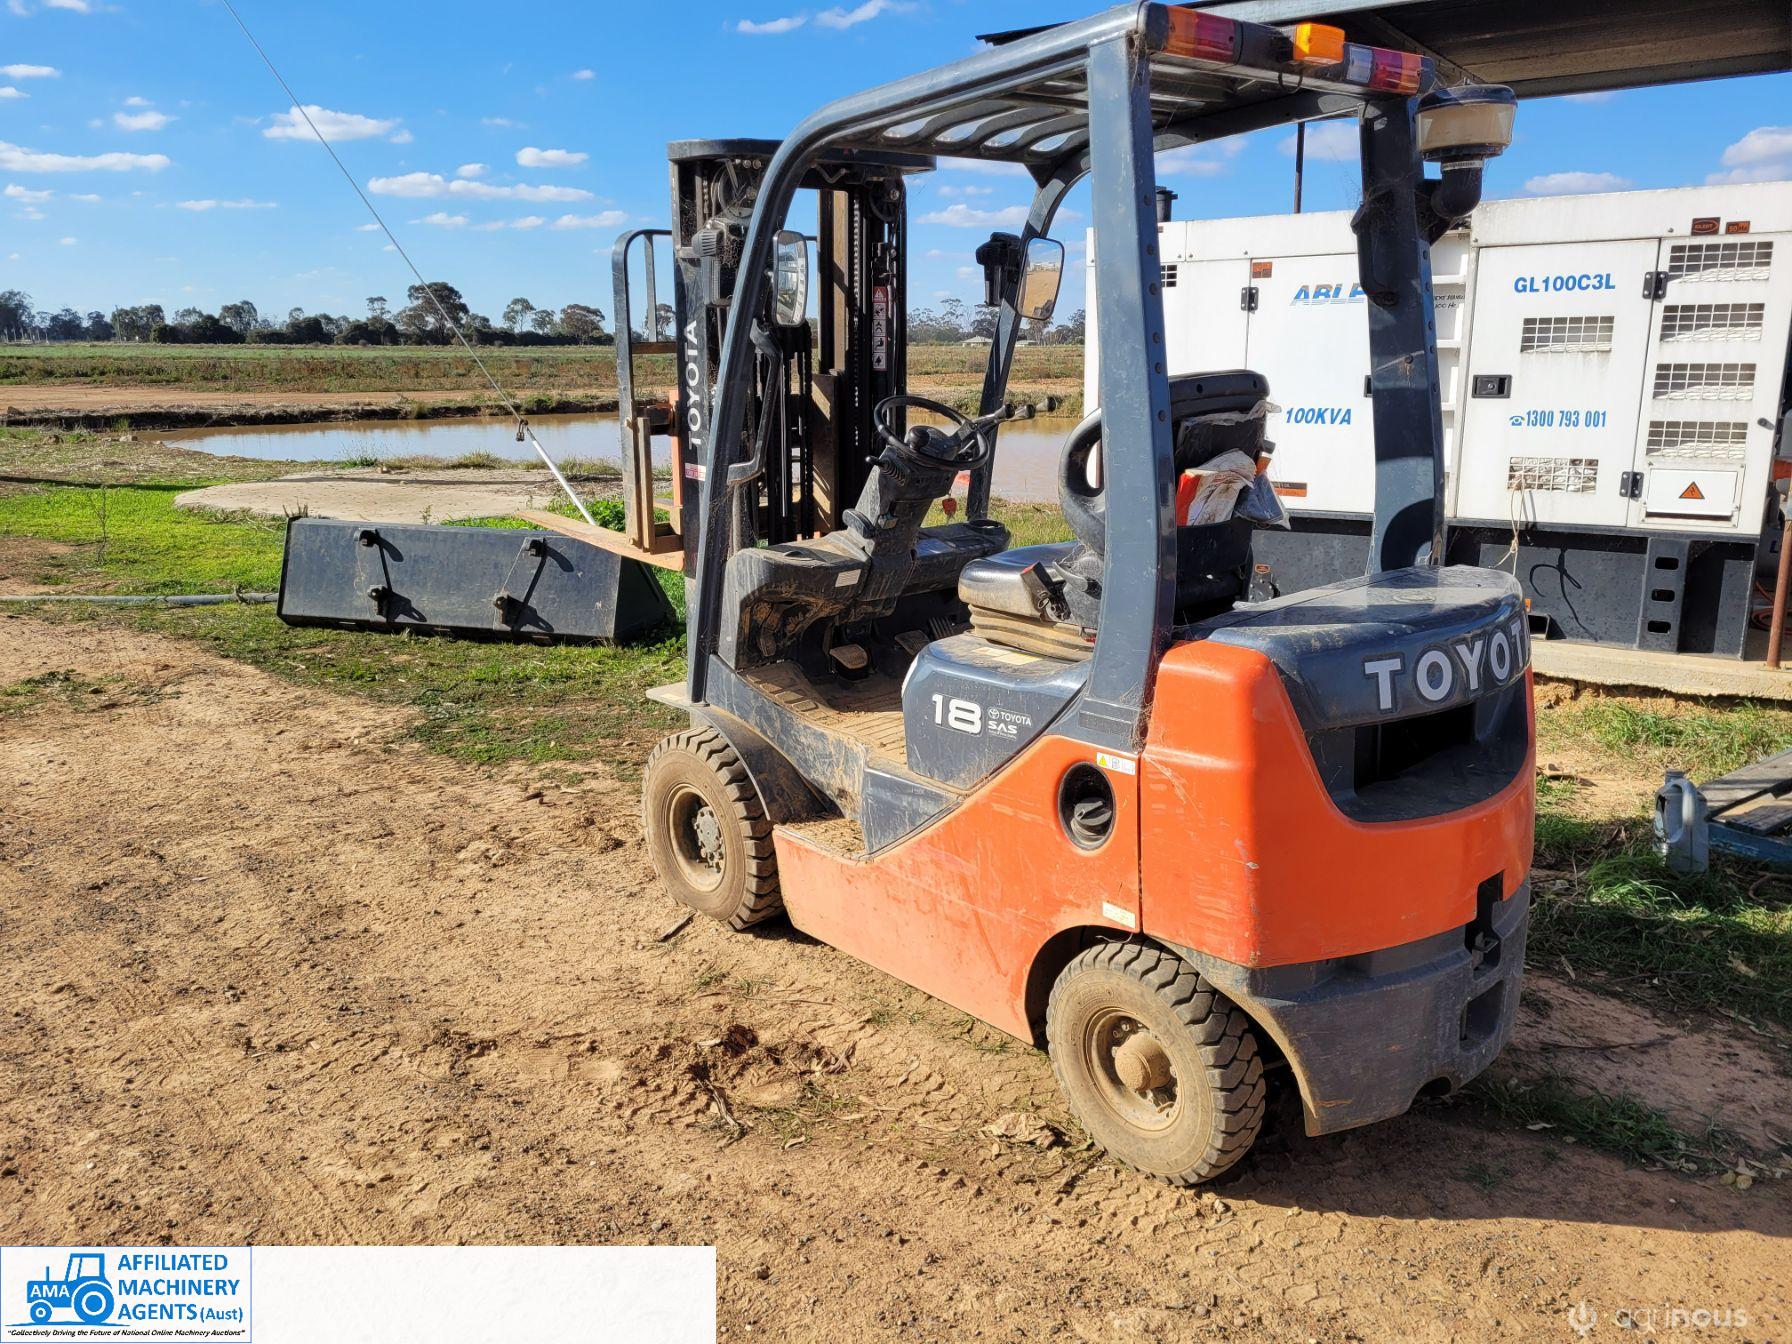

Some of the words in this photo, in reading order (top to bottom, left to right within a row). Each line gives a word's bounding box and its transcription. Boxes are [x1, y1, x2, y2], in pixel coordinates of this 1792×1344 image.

[1513, 273, 1616, 293] GL100C3L
[684, 320, 701, 450] TOYOTA
[1286, 407, 1352, 425] 100KVA
[1526, 410, 1554, 427] 1300
[1558, 410, 1580, 427] 793
[1585, 410, 1607, 427] 001
[931, 693, 982, 735] 18
[1000, 711, 1032, 726] TOYOTA
[988, 720, 1018, 734] SAS
